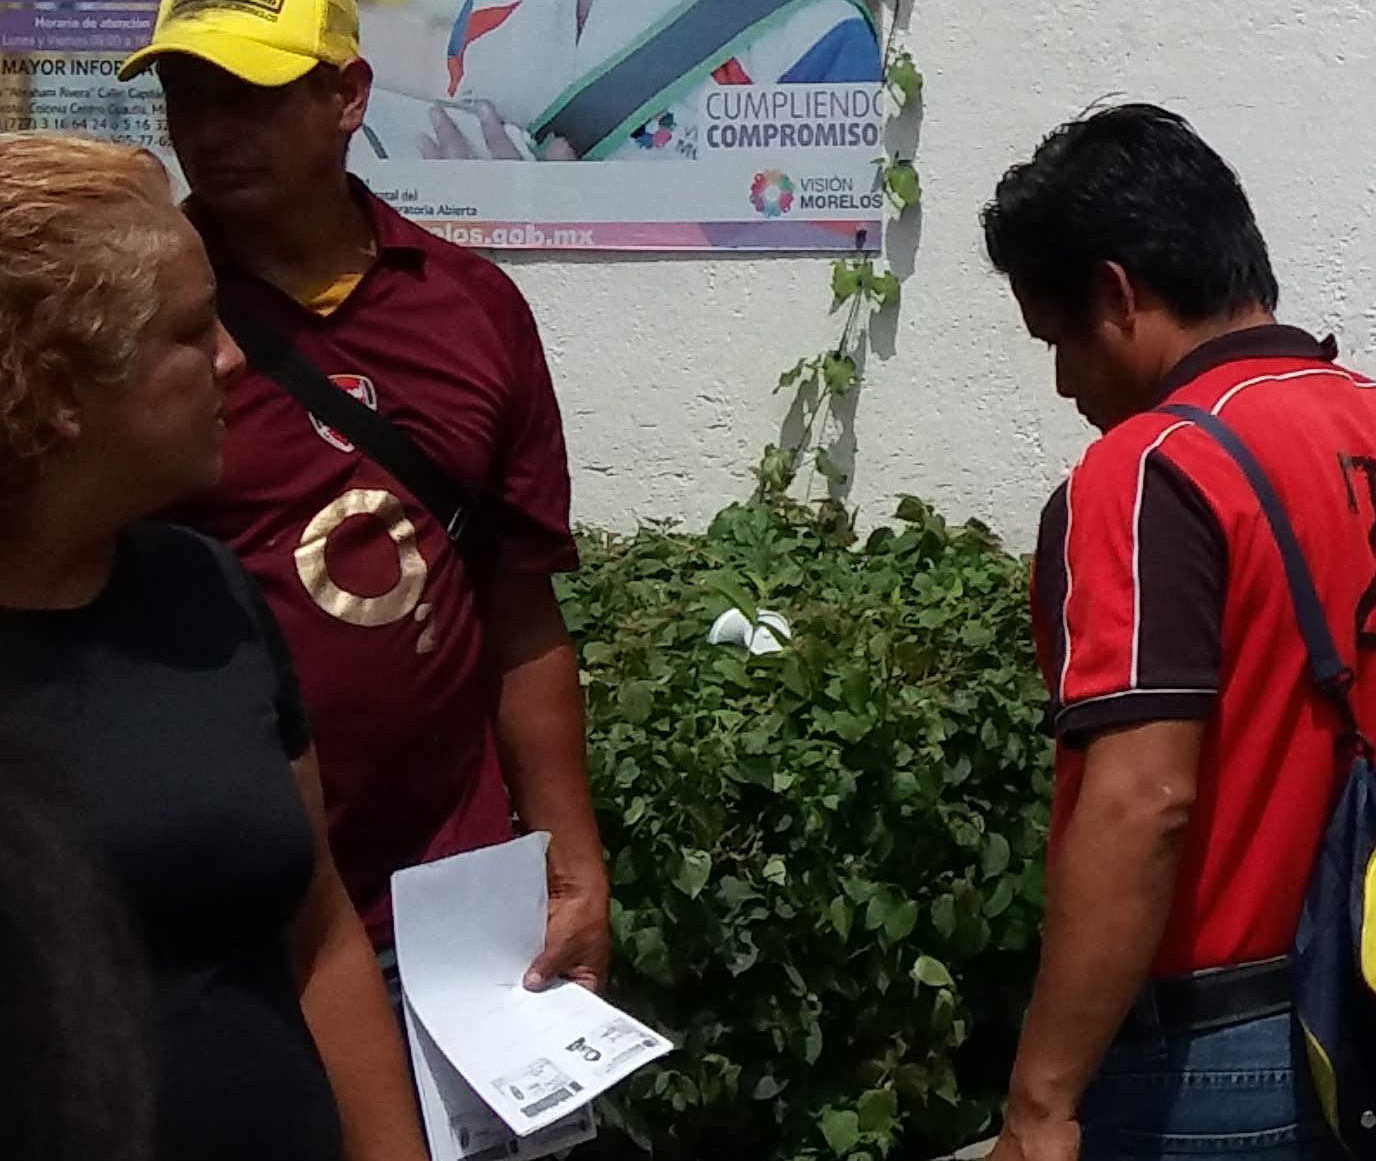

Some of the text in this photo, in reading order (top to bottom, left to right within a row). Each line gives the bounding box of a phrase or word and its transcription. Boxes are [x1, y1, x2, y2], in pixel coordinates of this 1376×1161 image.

[2, 59, 160, 76] MAYOR INFO
[707, 122, 883, 149] COMPROMISO
[437, 203, 478, 217] Abierta
[800, 193, 884, 210] MORELOS
